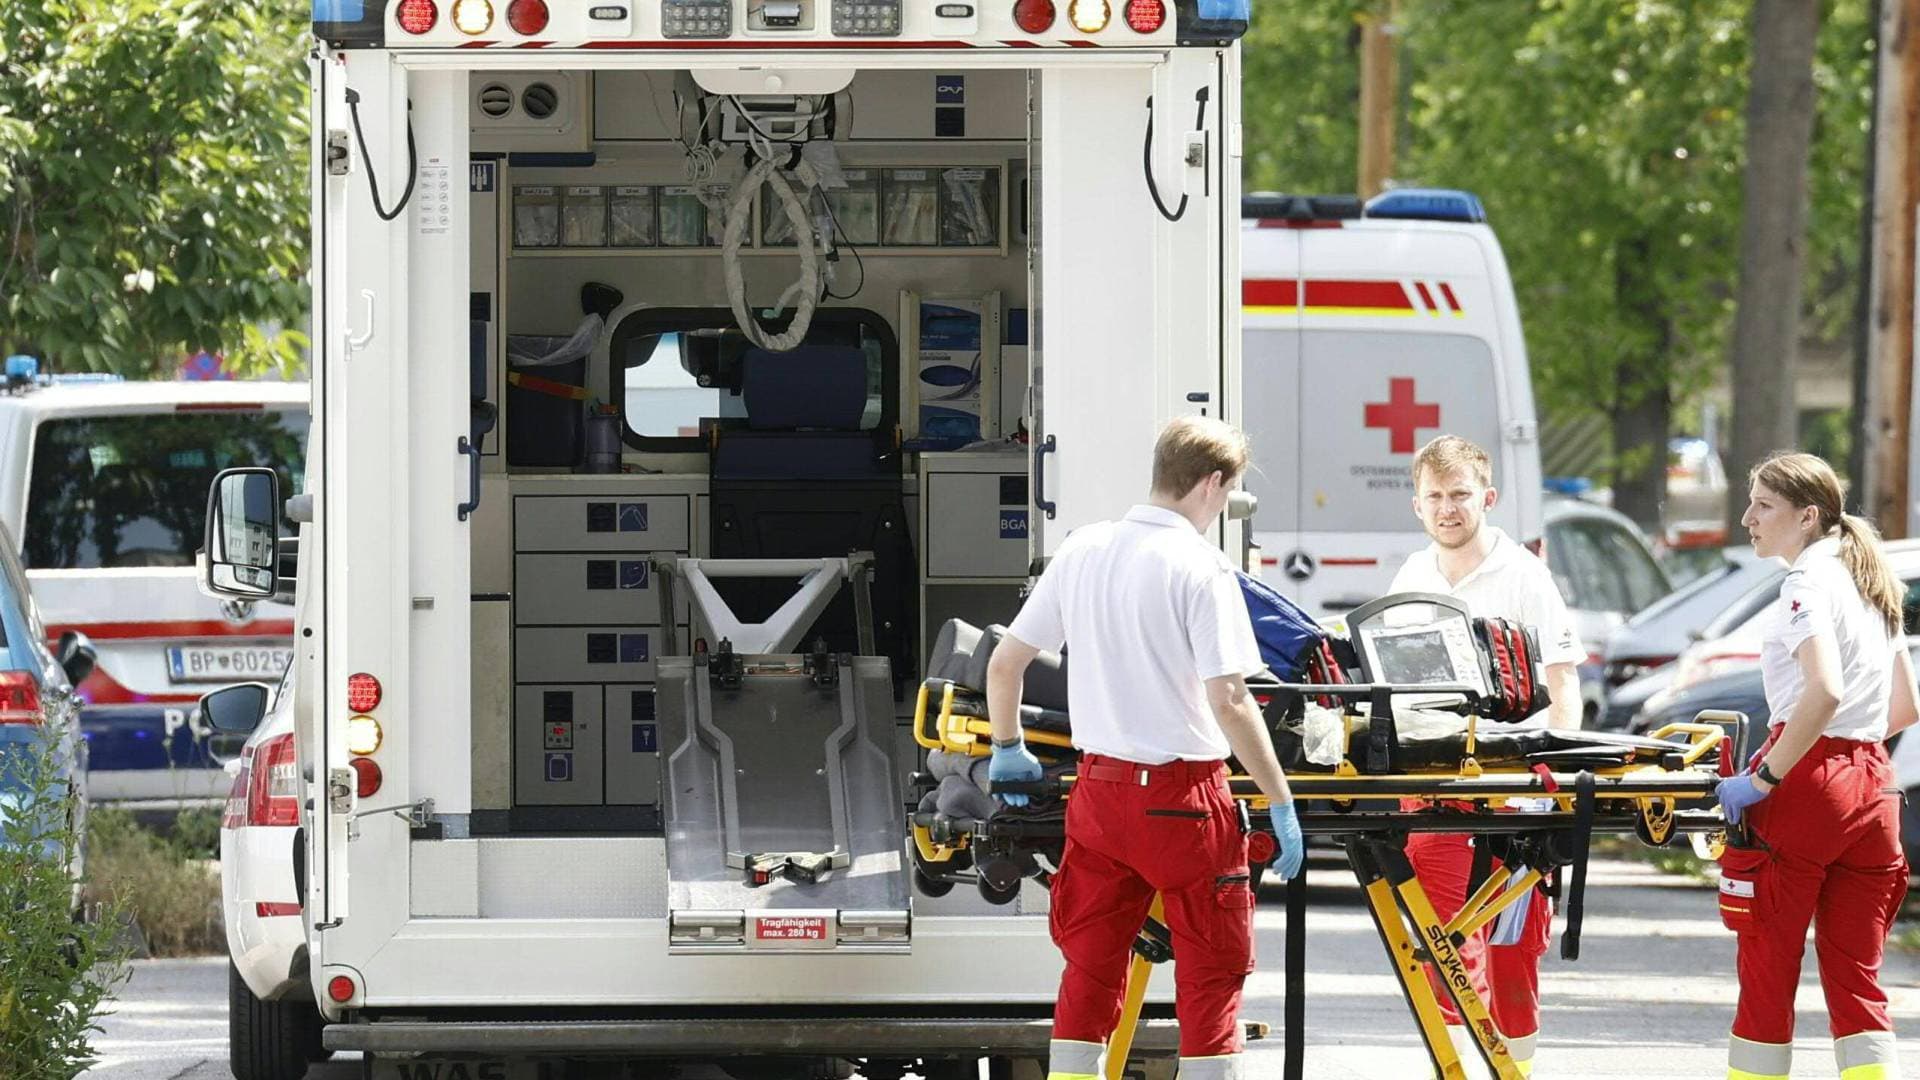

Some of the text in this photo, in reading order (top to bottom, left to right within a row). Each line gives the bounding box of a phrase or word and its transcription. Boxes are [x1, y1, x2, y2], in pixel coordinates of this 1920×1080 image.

[1000, 519, 1027, 530] BGA
[190, 651, 214, 672] BP
[760, 918, 821, 929] Tragfähigkeit
[763, 928, 819, 939] max. 280 kg
[1425, 923, 1473, 994] stryker
